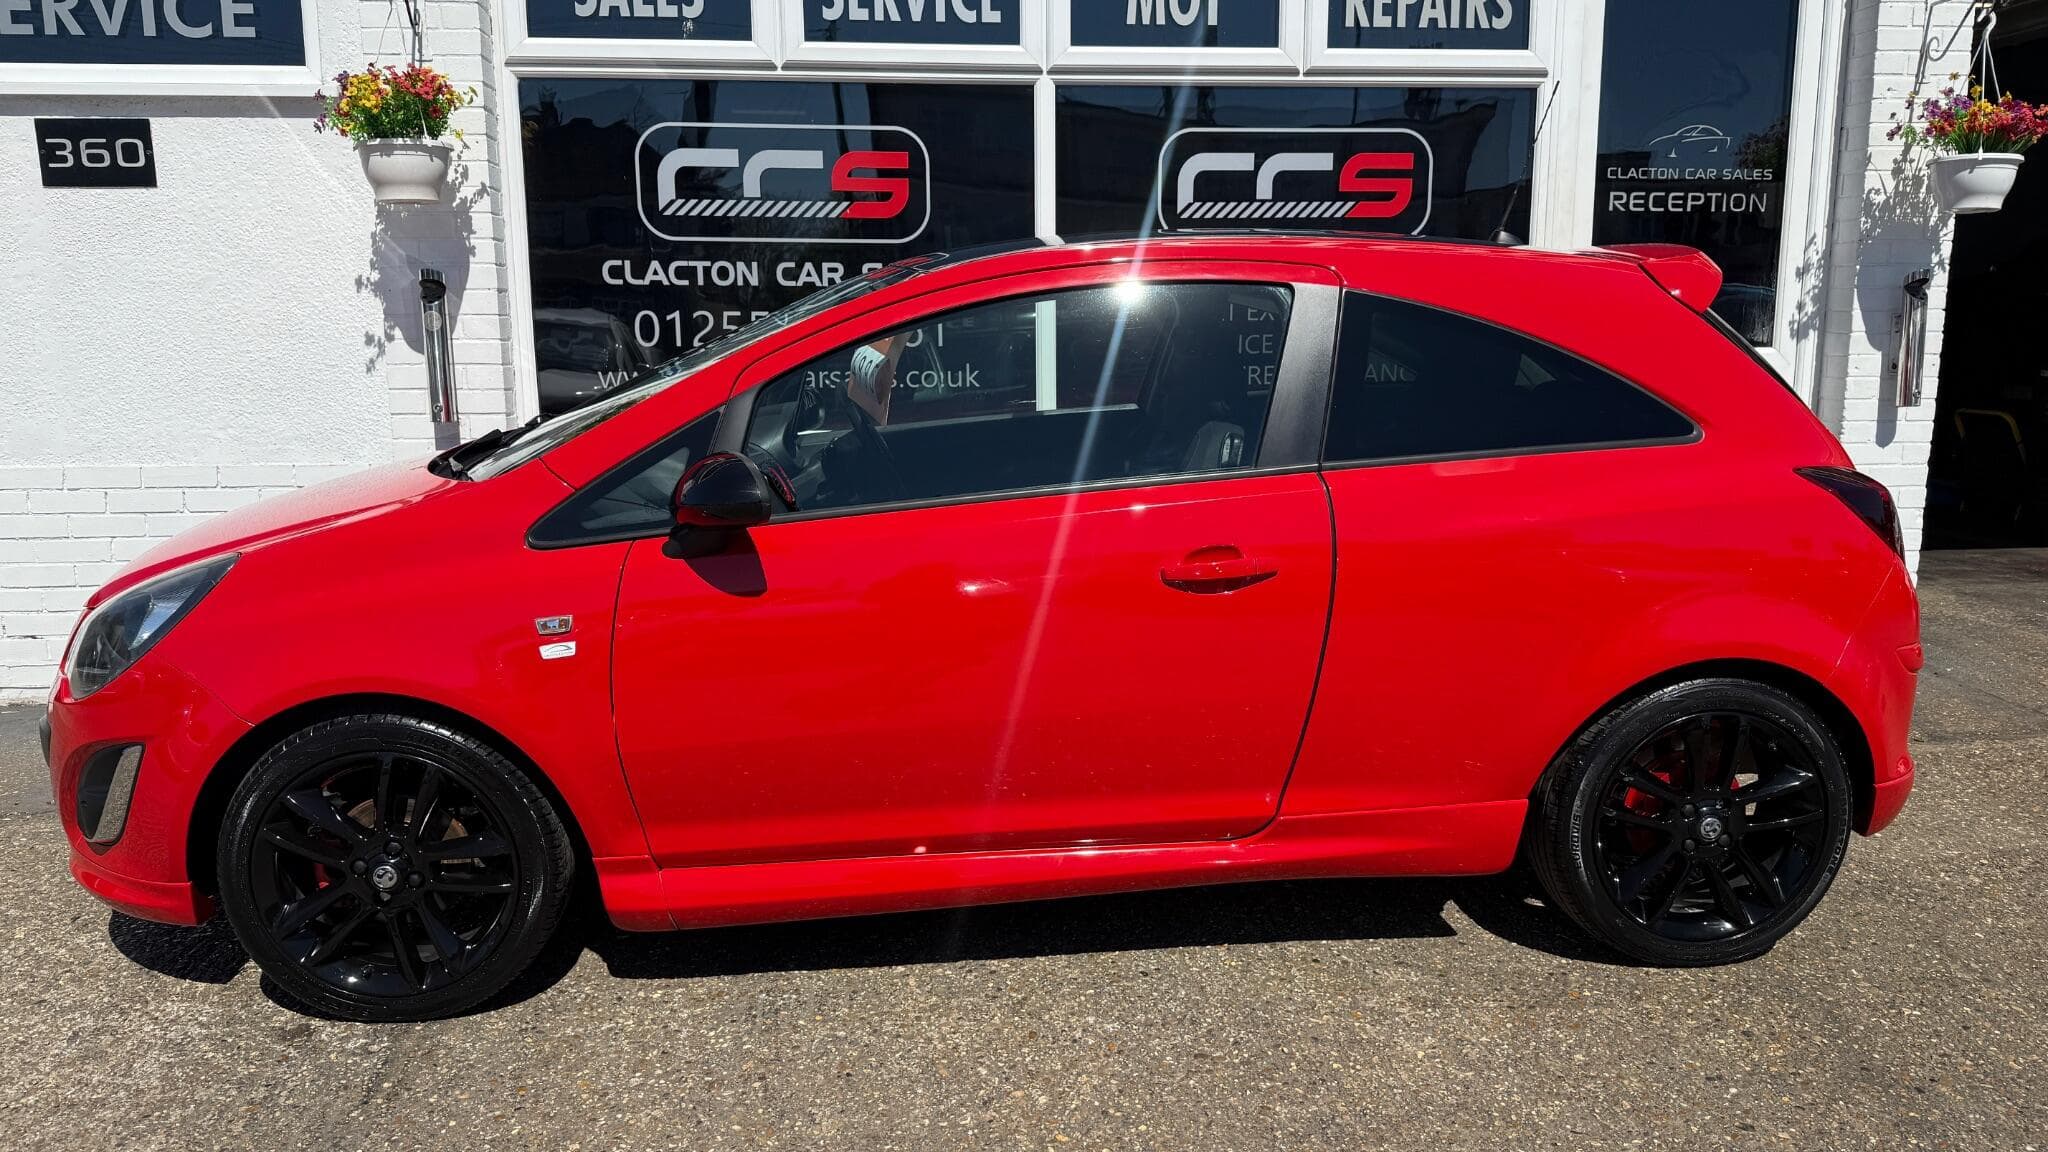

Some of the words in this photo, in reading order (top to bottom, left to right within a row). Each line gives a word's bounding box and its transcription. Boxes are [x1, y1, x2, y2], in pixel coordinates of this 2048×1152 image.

[821, 0, 1002, 23] SERVICE
[1344, 0, 1513, 30] REPAIRS
[45, 138, 146, 168] 360
[1607, 167, 1679, 180] CLACTON
[1684, 168, 1717, 180] CAR
[1722, 168, 1773, 181] SALES
[1608, 191, 1767, 213] RECEPTION
[602, 260, 758, 286] CLACTON
[776, 261, 845, 287] CAR
